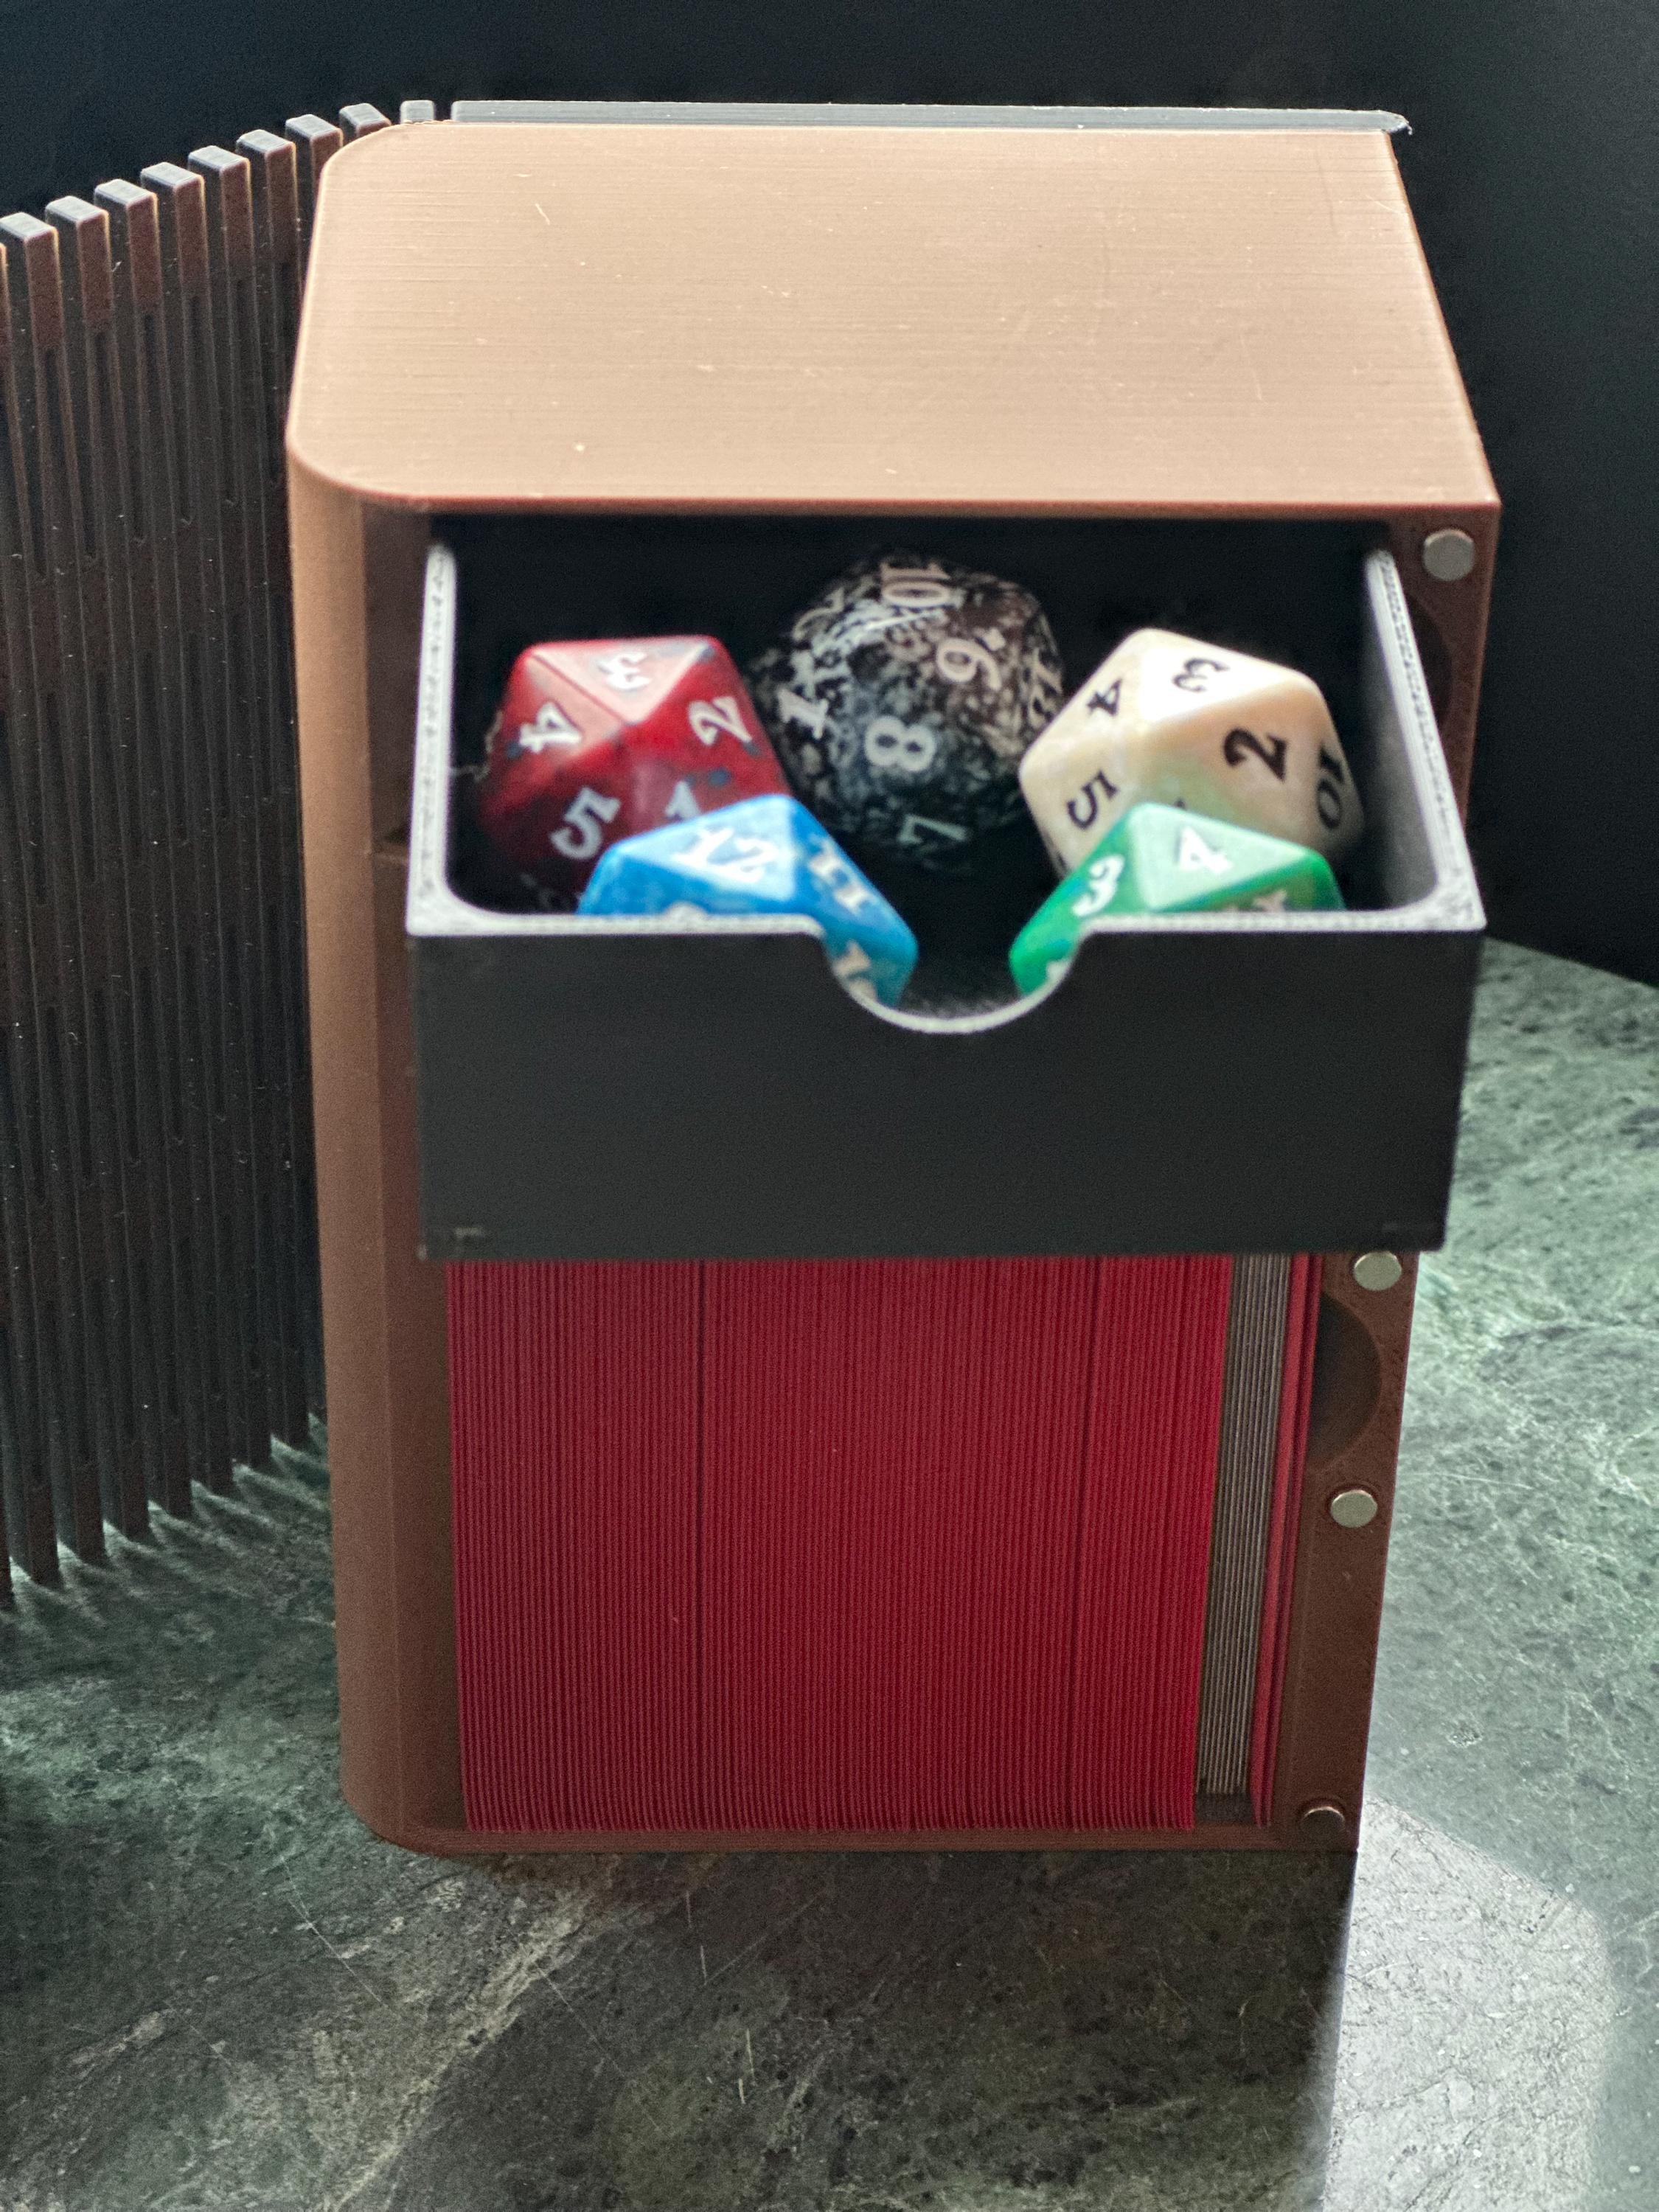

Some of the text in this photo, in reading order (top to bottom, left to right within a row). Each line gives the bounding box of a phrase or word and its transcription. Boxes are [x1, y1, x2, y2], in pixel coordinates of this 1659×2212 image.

[597, 652, 651, 690] 3
[1085, 678, 1124, 717] 4
[1172, 657, 1230, 692] 3
[519, 701, 582, 754] 4
[688, 696, 753, 747] 2
[864, 714, 937, 772] 8
[1223, 727, 1288, 782] 2
[549, 787, 622, 860] 5
[1065, 770, 1119, 831] 5
[671, 827, 781, 883] 12
[1178, 825, 1234, 873] 4
[1071, 855, 1126, 917] 3
